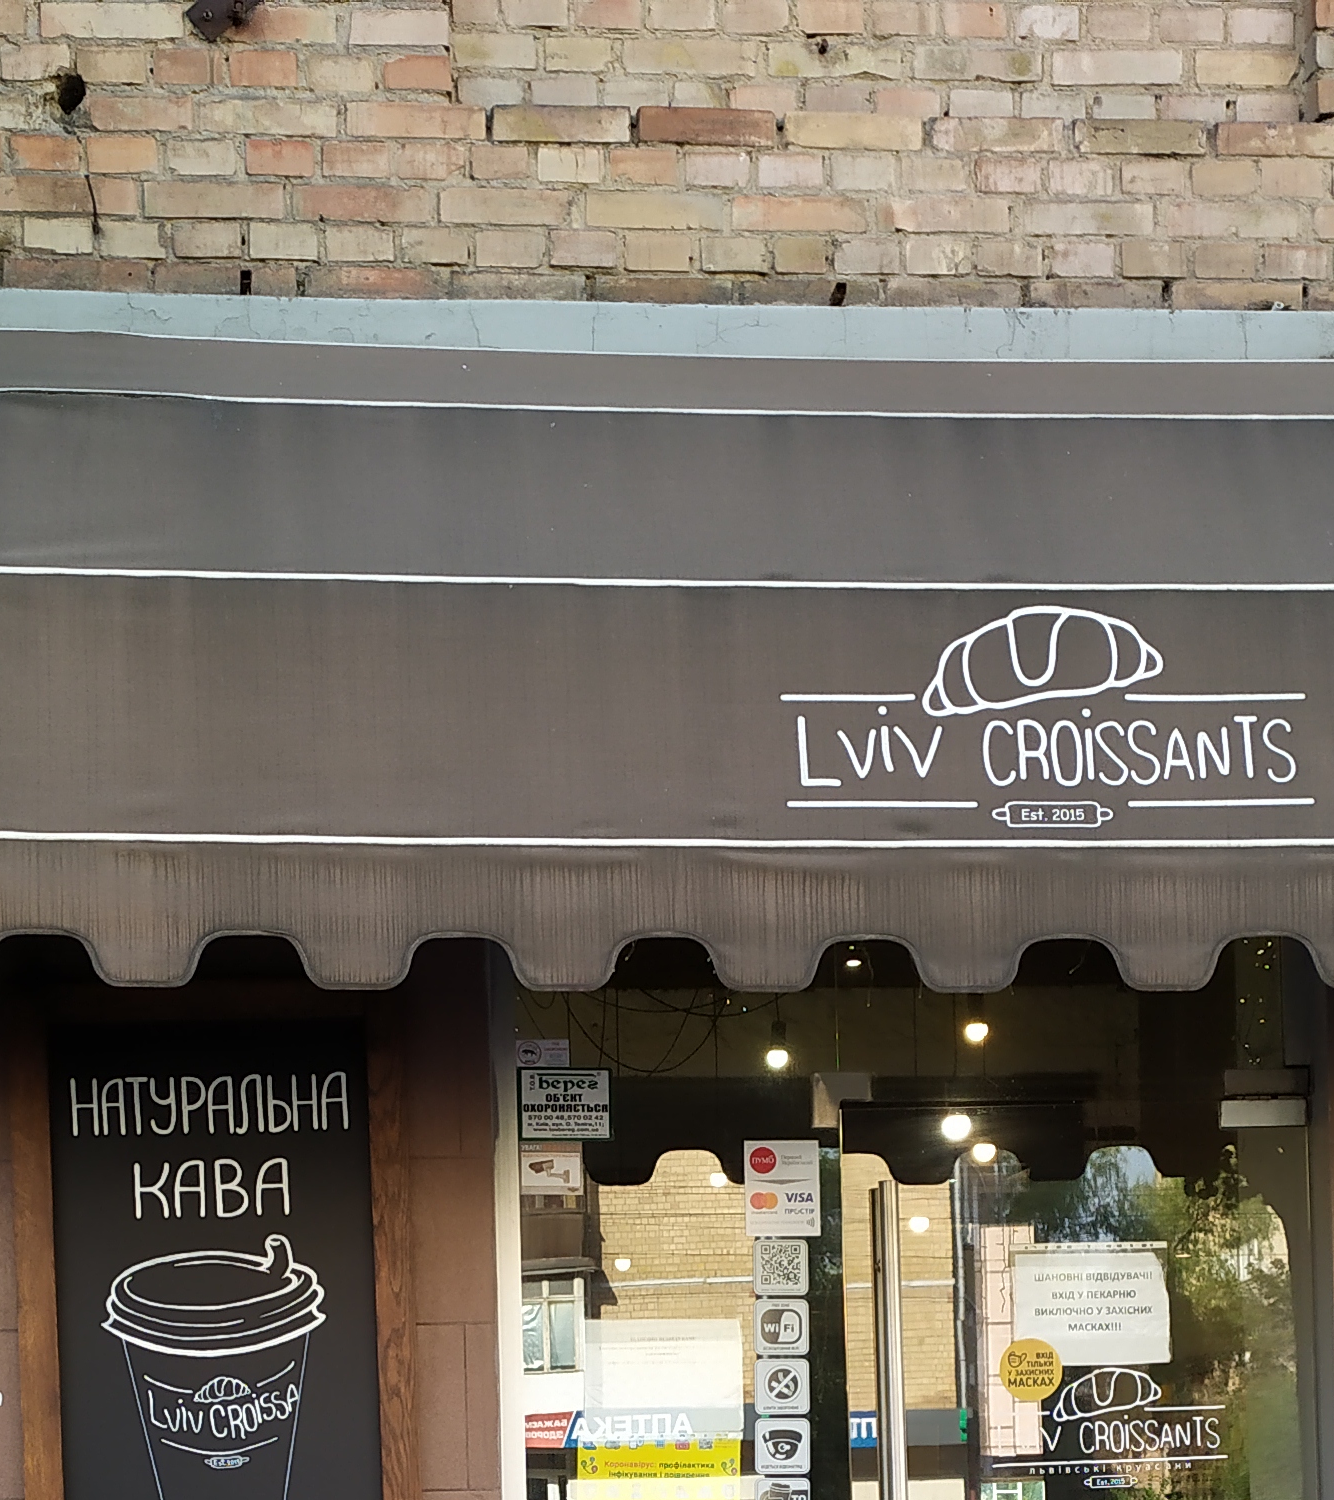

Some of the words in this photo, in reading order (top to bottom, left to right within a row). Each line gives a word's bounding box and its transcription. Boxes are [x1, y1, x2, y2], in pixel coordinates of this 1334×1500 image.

[1052, 808, 1085, 821] 2015
[70, 1071, 349, 1136] НАТУРАЛЬНА
[523, 1104, 608, 1113] ОХОРОНЯЄТЬСЯ
[133, 1157, 291, 1219] КАВА
[785, 1192, 814, 1203] VISA
[1034, 1273, 1083, 1282] ШАНОВНІ
[1052, 1291, 1075, 1301] ВХІД
[1077, 1291, 1084, 1300] У
[1087, 1289, 1136, 1299] ПЕКАРНЮ
[1034, 1307, 1094, 1316] ВИКЛЮЧНО
[1096, 1307, 1103, 1315] У
[1008, 1377, 1055, 1387] МАСКАХ
[659, 1461, 715, 1470] профілактика
